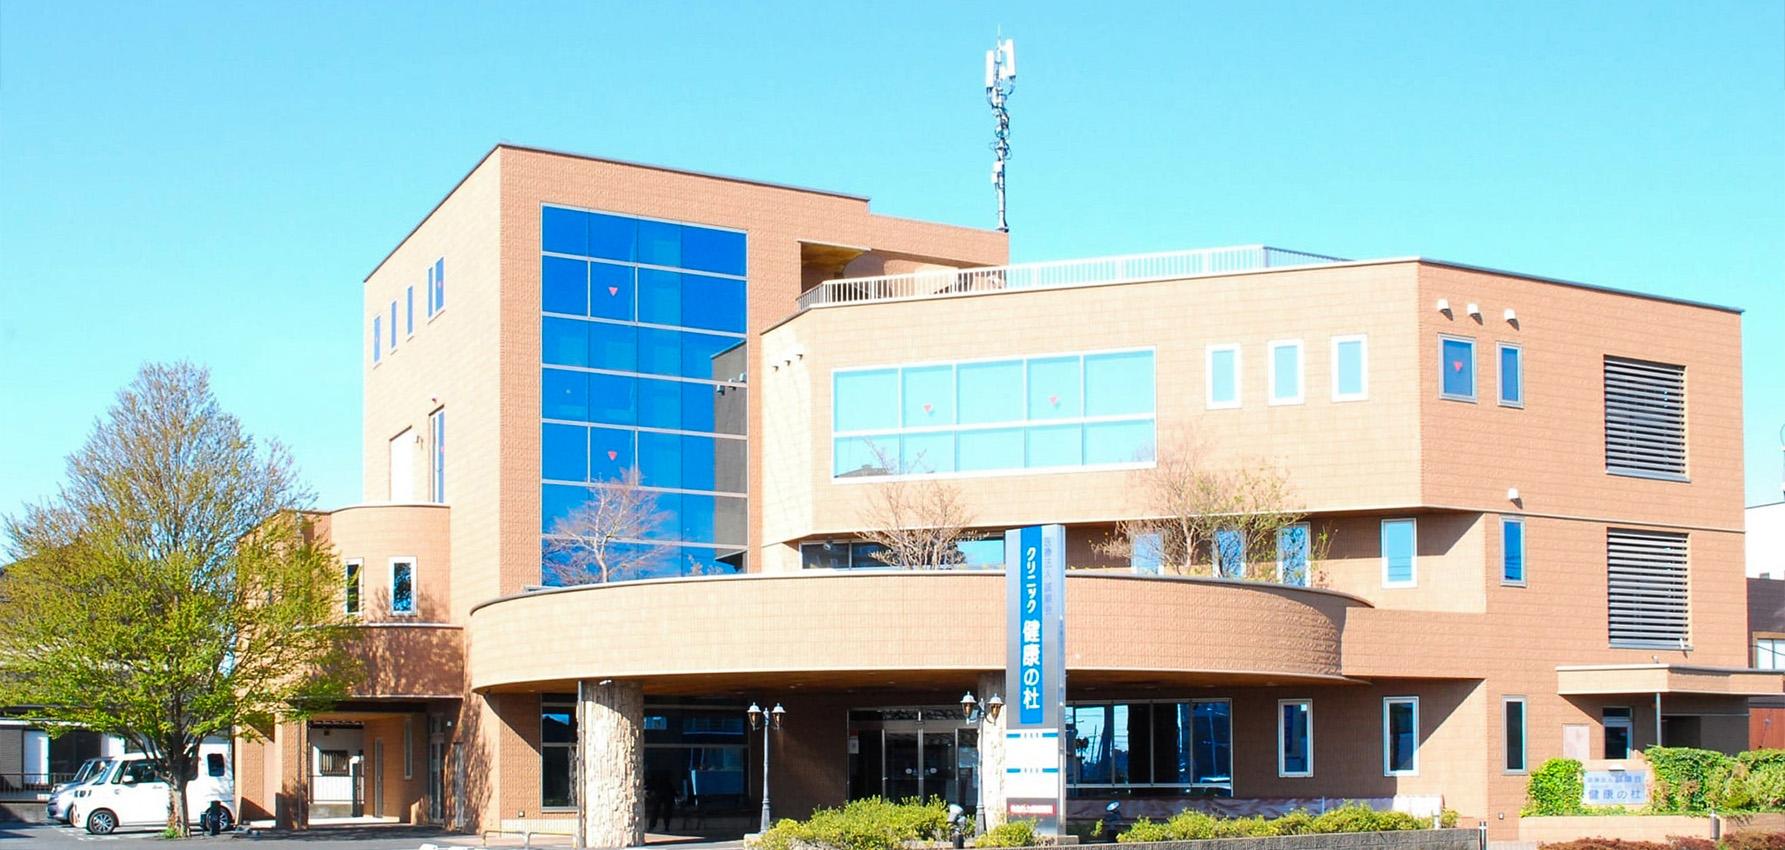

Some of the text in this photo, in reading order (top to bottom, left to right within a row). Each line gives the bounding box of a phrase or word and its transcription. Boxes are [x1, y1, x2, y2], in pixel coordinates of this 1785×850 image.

[1022, 547, 1041, 710] クリニック 健康の杜
